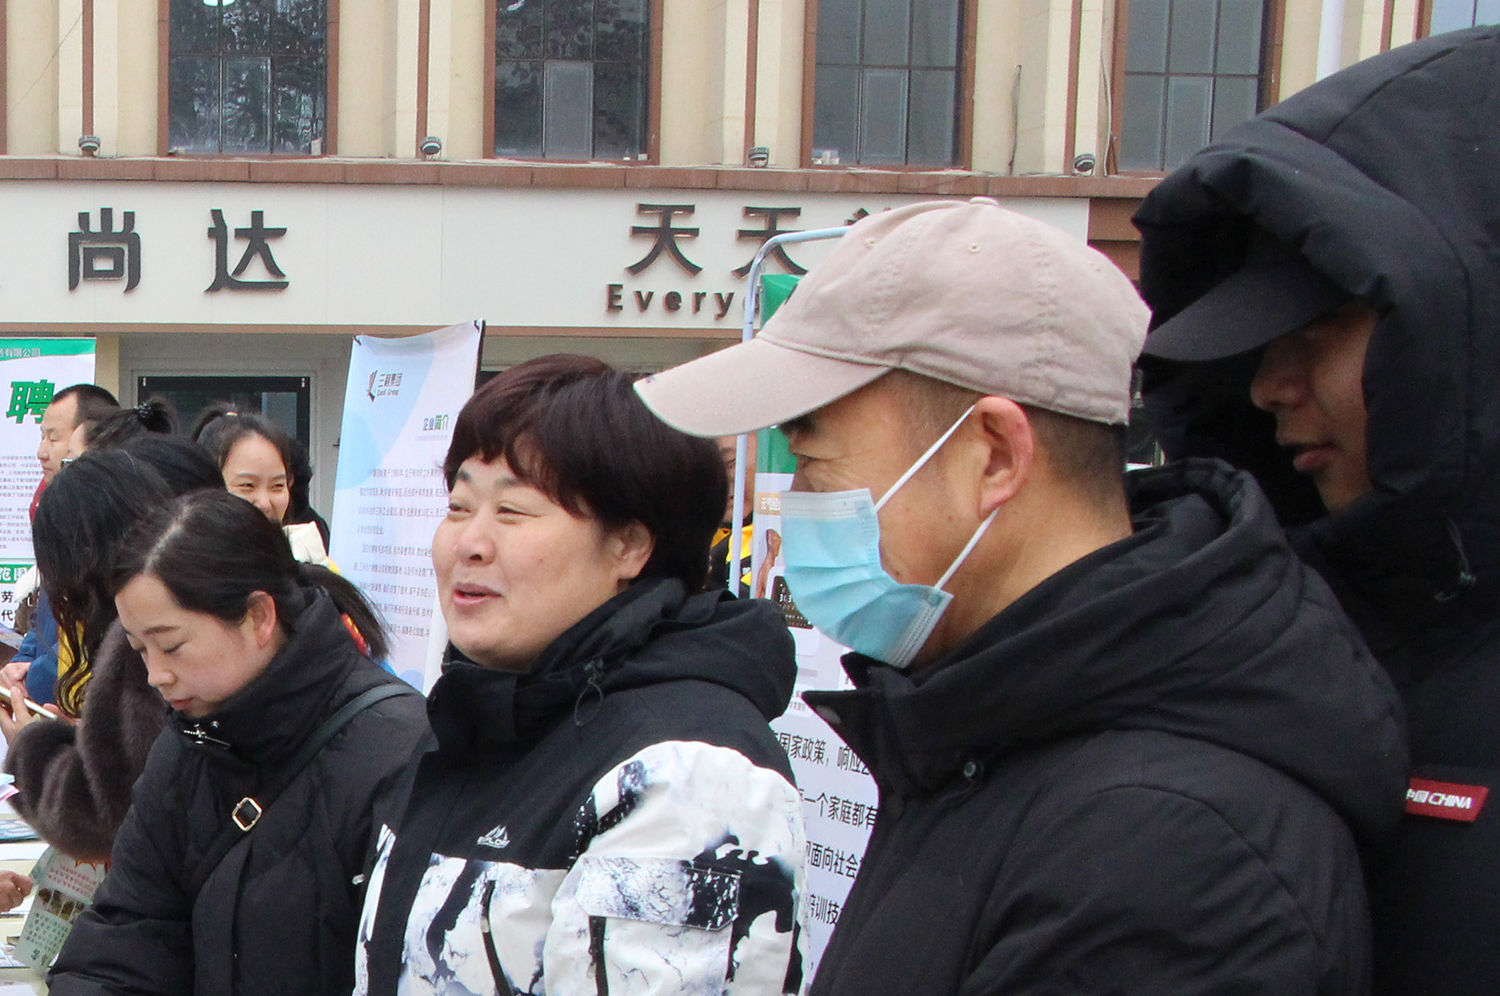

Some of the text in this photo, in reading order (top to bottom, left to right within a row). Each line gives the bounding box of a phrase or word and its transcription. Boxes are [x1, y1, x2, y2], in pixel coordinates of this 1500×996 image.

[625, 203, 892, 279] 天天
[774, 732, 870, 776] 国家政策，响应
[806, 840, 864, 879] 面向社会
